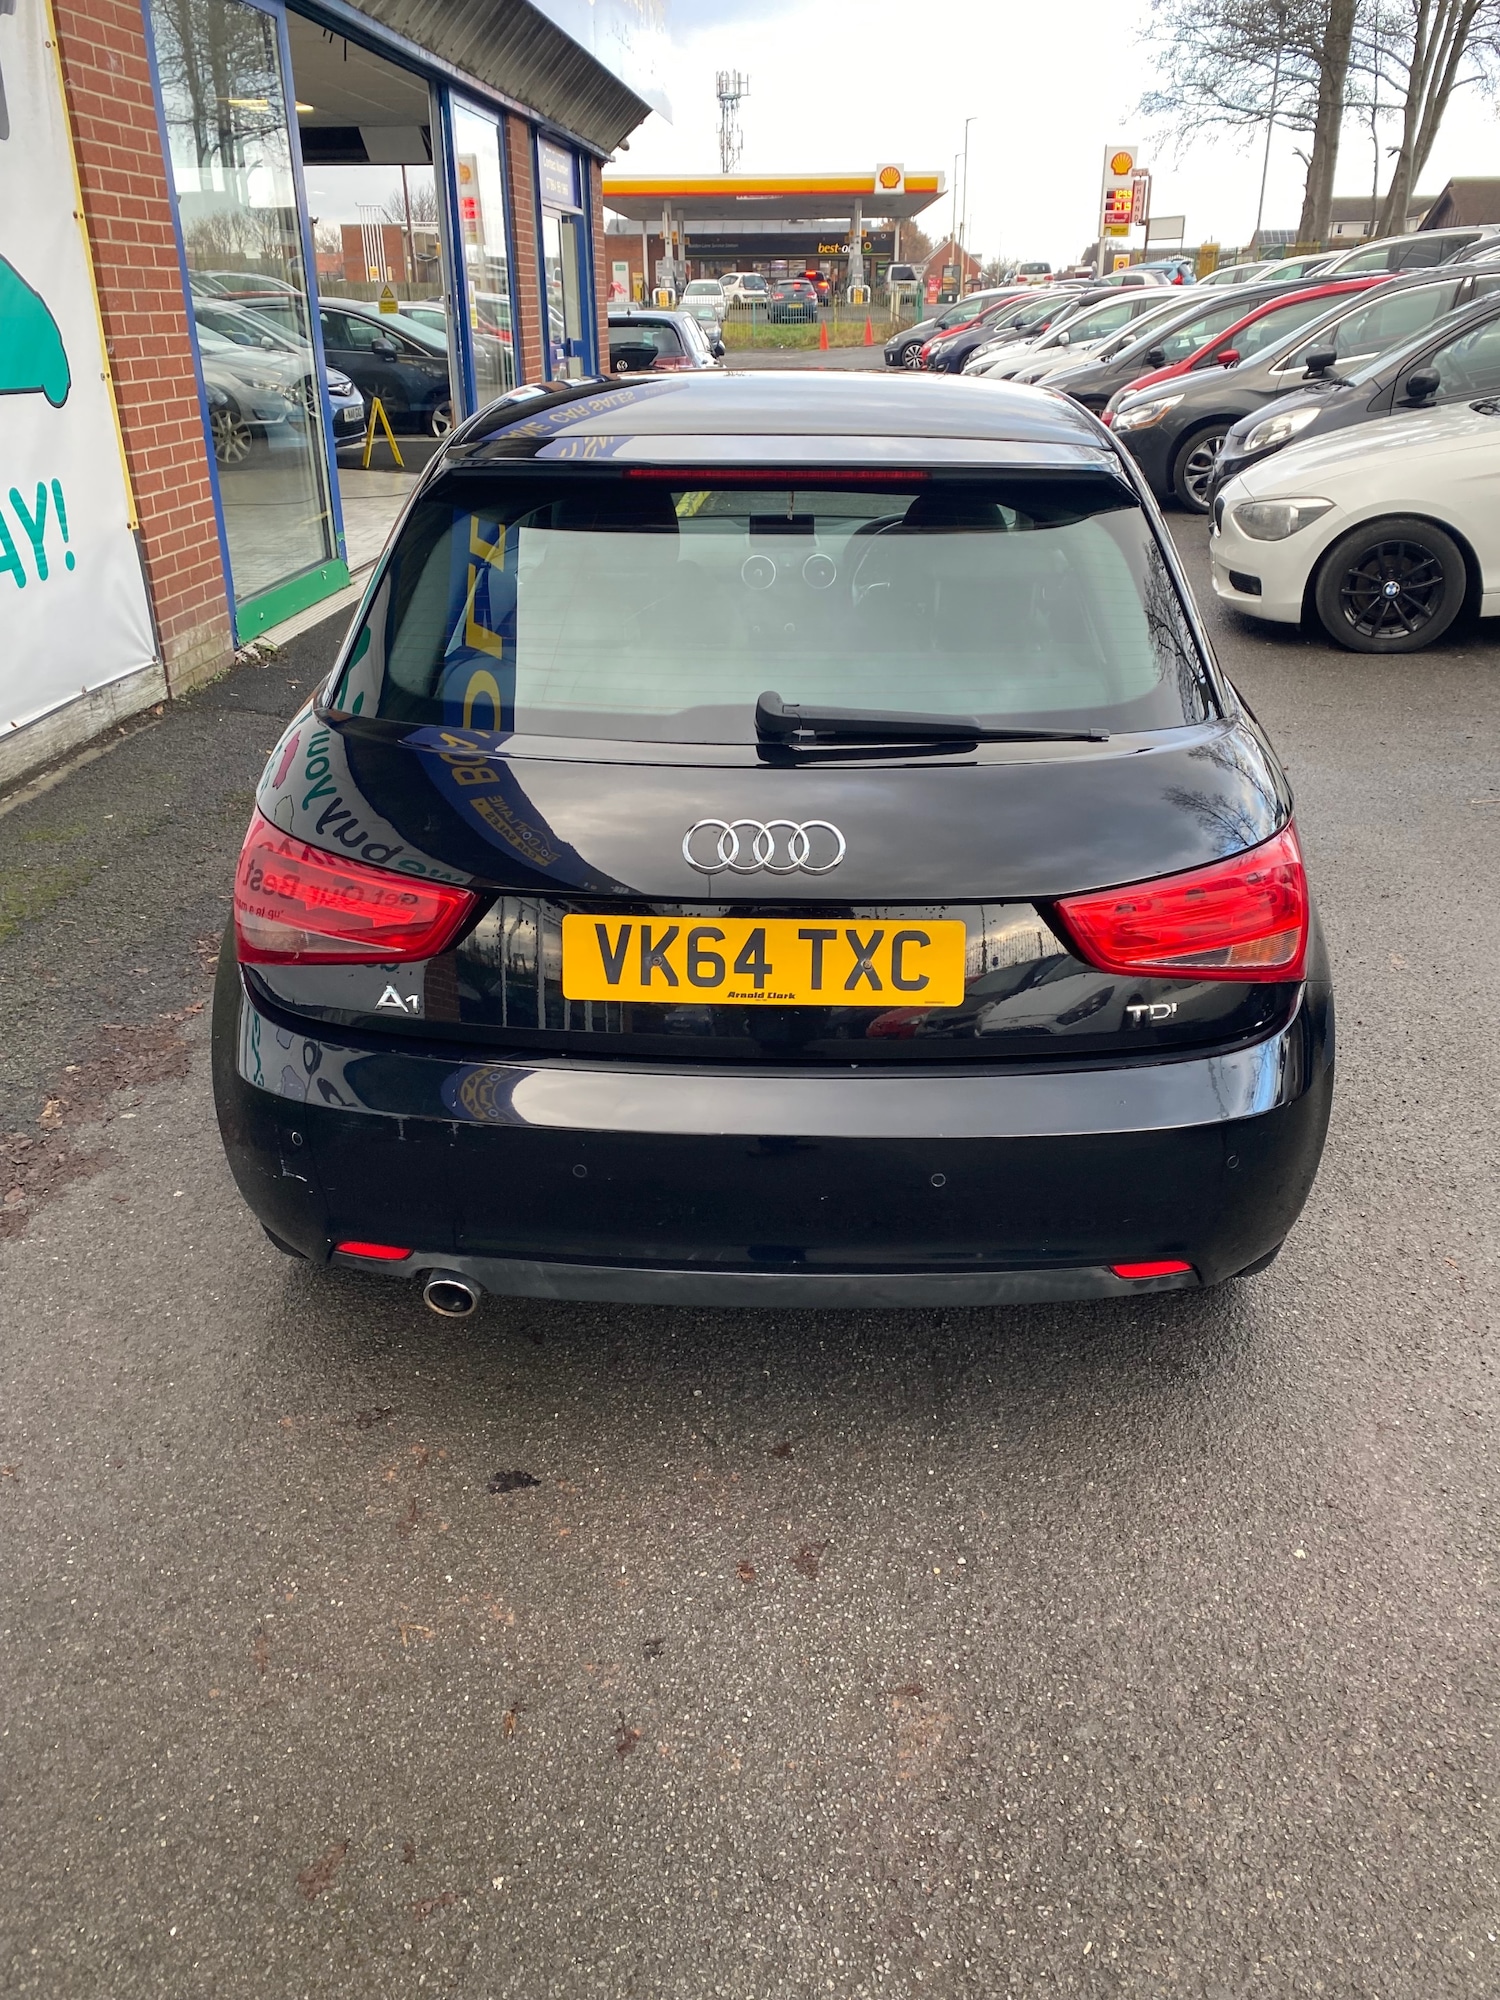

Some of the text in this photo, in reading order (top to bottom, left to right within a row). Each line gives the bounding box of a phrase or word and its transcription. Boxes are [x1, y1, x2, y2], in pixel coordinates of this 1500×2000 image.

[818, 242, 850, 254] best-o
[594, 923, 932, 992] VK64 TXC
[374, 985, 420, 1014] A1
[727, 991, 765, 999] Arnold
[1126, 1003, 1178, 1022] TDI
